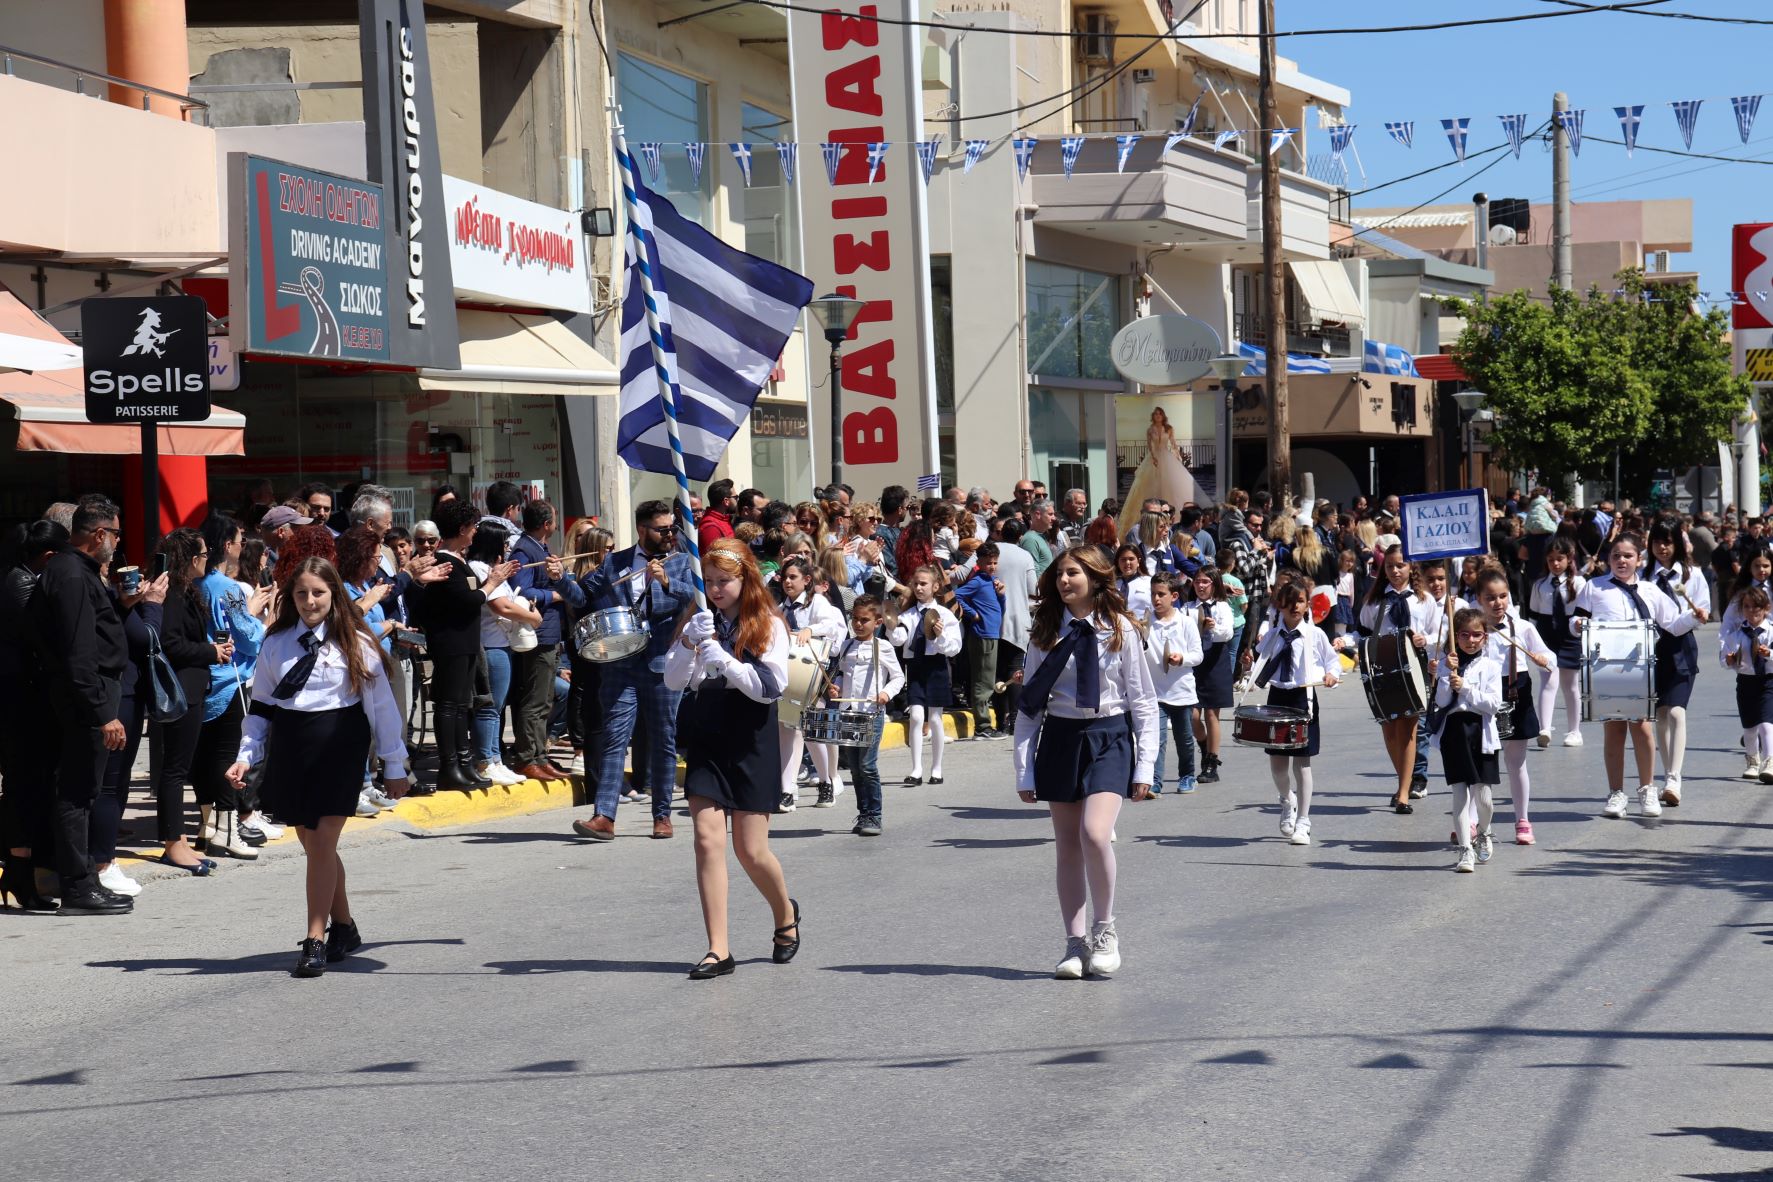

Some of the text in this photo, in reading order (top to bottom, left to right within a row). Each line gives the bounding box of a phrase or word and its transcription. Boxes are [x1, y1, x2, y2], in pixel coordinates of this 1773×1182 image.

[279, 172, 380, 229] ΣΧΟΛΗ ΟΔΗΓΩΝ
[291, 229, 381, 270] DRIVING ACADEMY
[339, 282, 383, 316] ΣΙΩΚΟΣ
[89, 367, 204, 400] Spells
[115, 406, 179, 416] PATISSERIE
[754, 406, 776, 434] Das
[1417, 502, 1469, 519] Κ.Δ.Α.Π
[1416, 520, 1472, 538] ΓΑΖΙΟΥ
